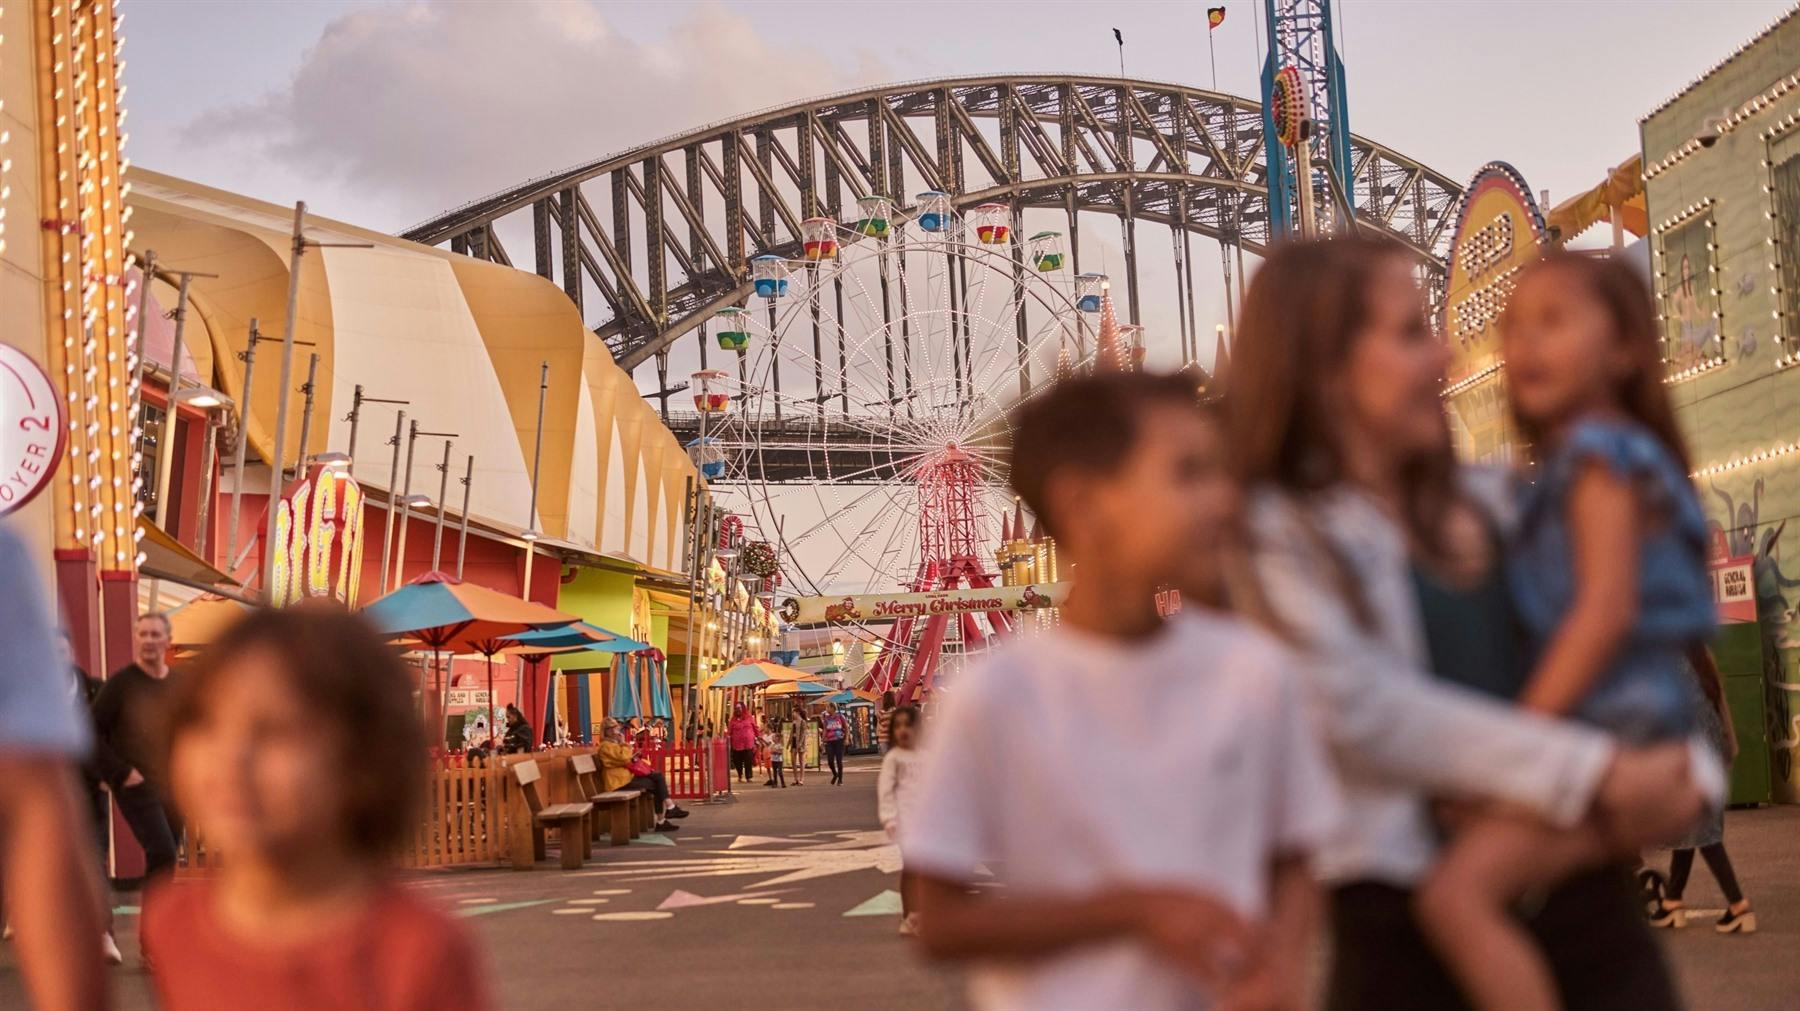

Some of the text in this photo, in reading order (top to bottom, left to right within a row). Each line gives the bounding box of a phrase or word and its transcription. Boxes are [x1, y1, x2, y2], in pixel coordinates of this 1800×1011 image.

[19, 416, 50, 432] 2
[271, 465, 337, 609] BIG
[872, 597, 1003, 617] Merry Christmas
